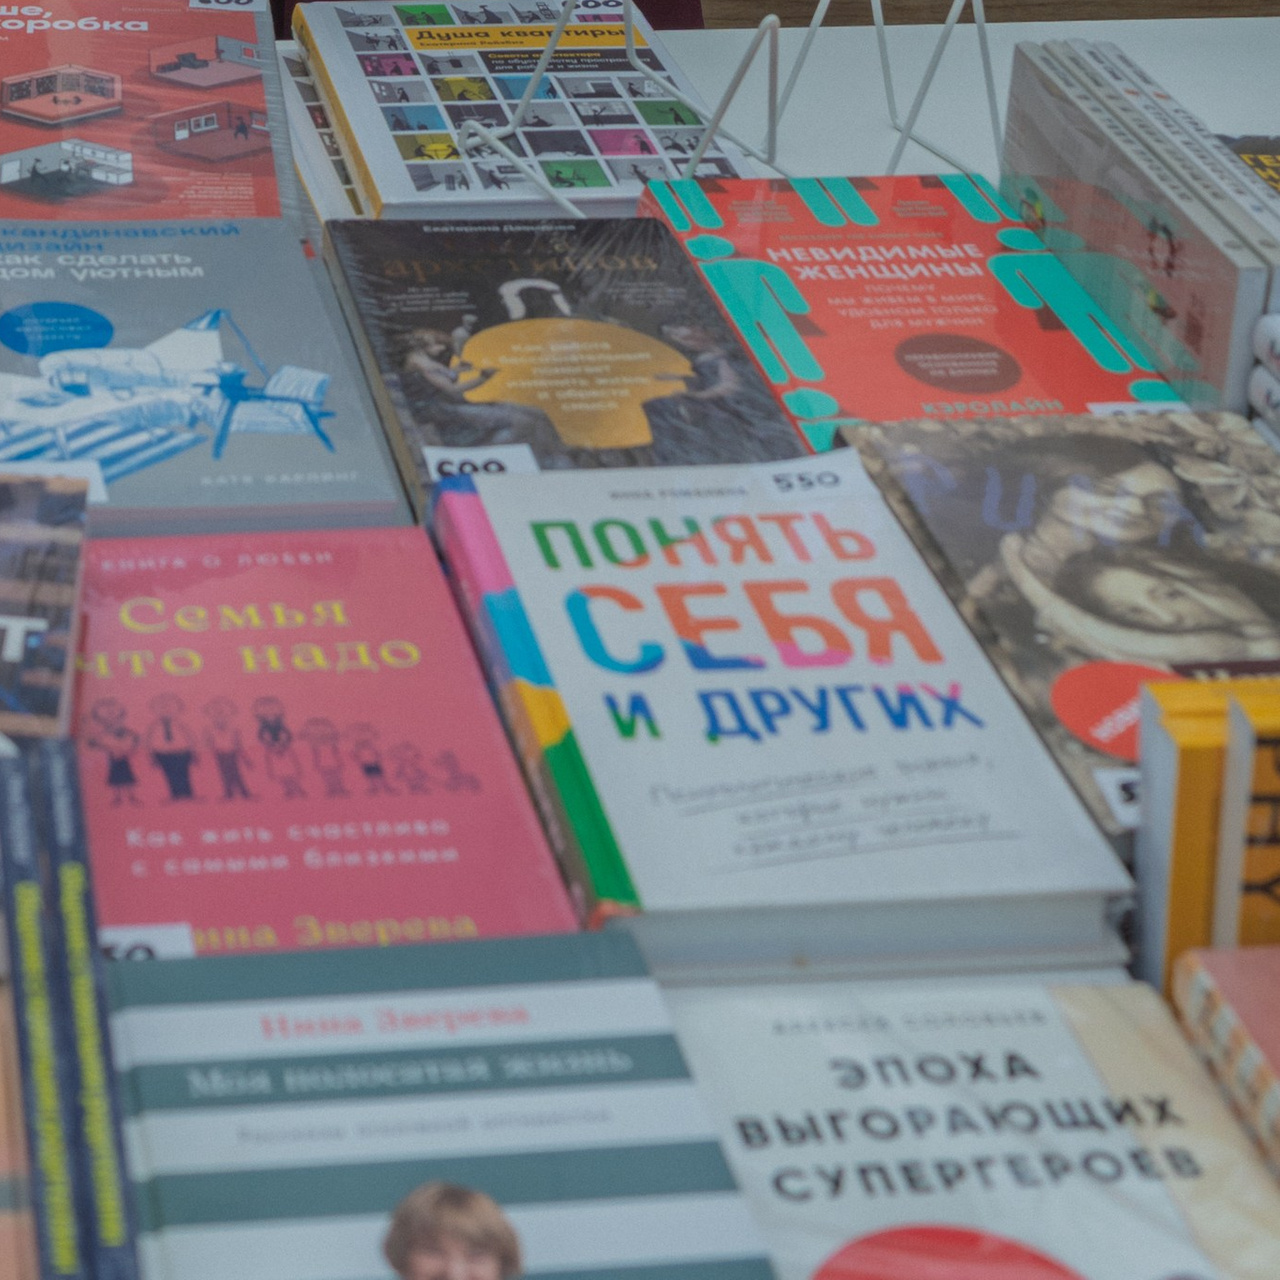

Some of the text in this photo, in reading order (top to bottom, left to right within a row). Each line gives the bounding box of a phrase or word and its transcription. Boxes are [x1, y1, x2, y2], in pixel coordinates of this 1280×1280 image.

[416, 30, 491, 41] Душа
[56, 252, 193, 268] сделать
[766, 243, 985, 264] НЕВИДИМЫЕ
[793, 262, 985, 281] ЖЕНЩИНЫ
[70, 265, 205, 282] уютным
[527, 510, 880, 570] ПОНЯТЬ
[119, 594, 353, 635] Семья
[562, 575, 947, 675] СЕБЯ
[238, 638, 423, 676] надо
[603, 680, 986, 745] И ДРУГИХ
[829, 1050, 1042, 1089] ЭПОХА
[734, 1094, 1187, 1151] ВЫГОРАЮЩИХ
[772, 1145, 1205, 1203] СУПЕРГЕРОЕВ
